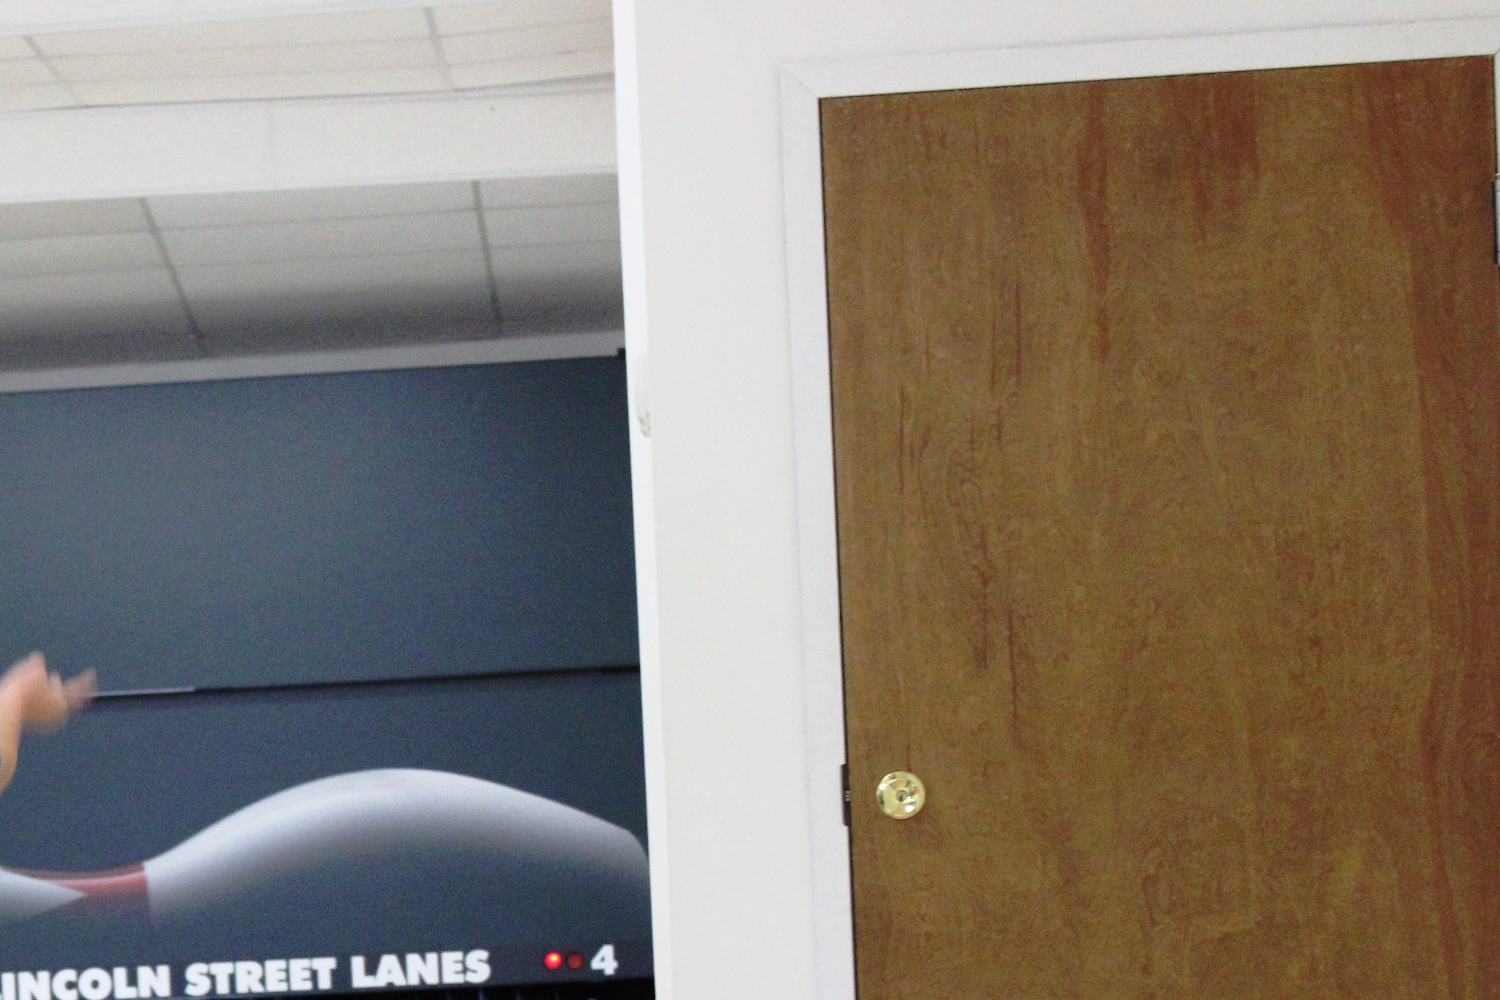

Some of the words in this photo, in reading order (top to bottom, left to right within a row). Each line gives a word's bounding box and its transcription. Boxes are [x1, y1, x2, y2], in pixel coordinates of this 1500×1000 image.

[185, 956, 338, 997] STREET
[350, 949, 492, 989] LANES
[590, 944, 619, 977] 4
